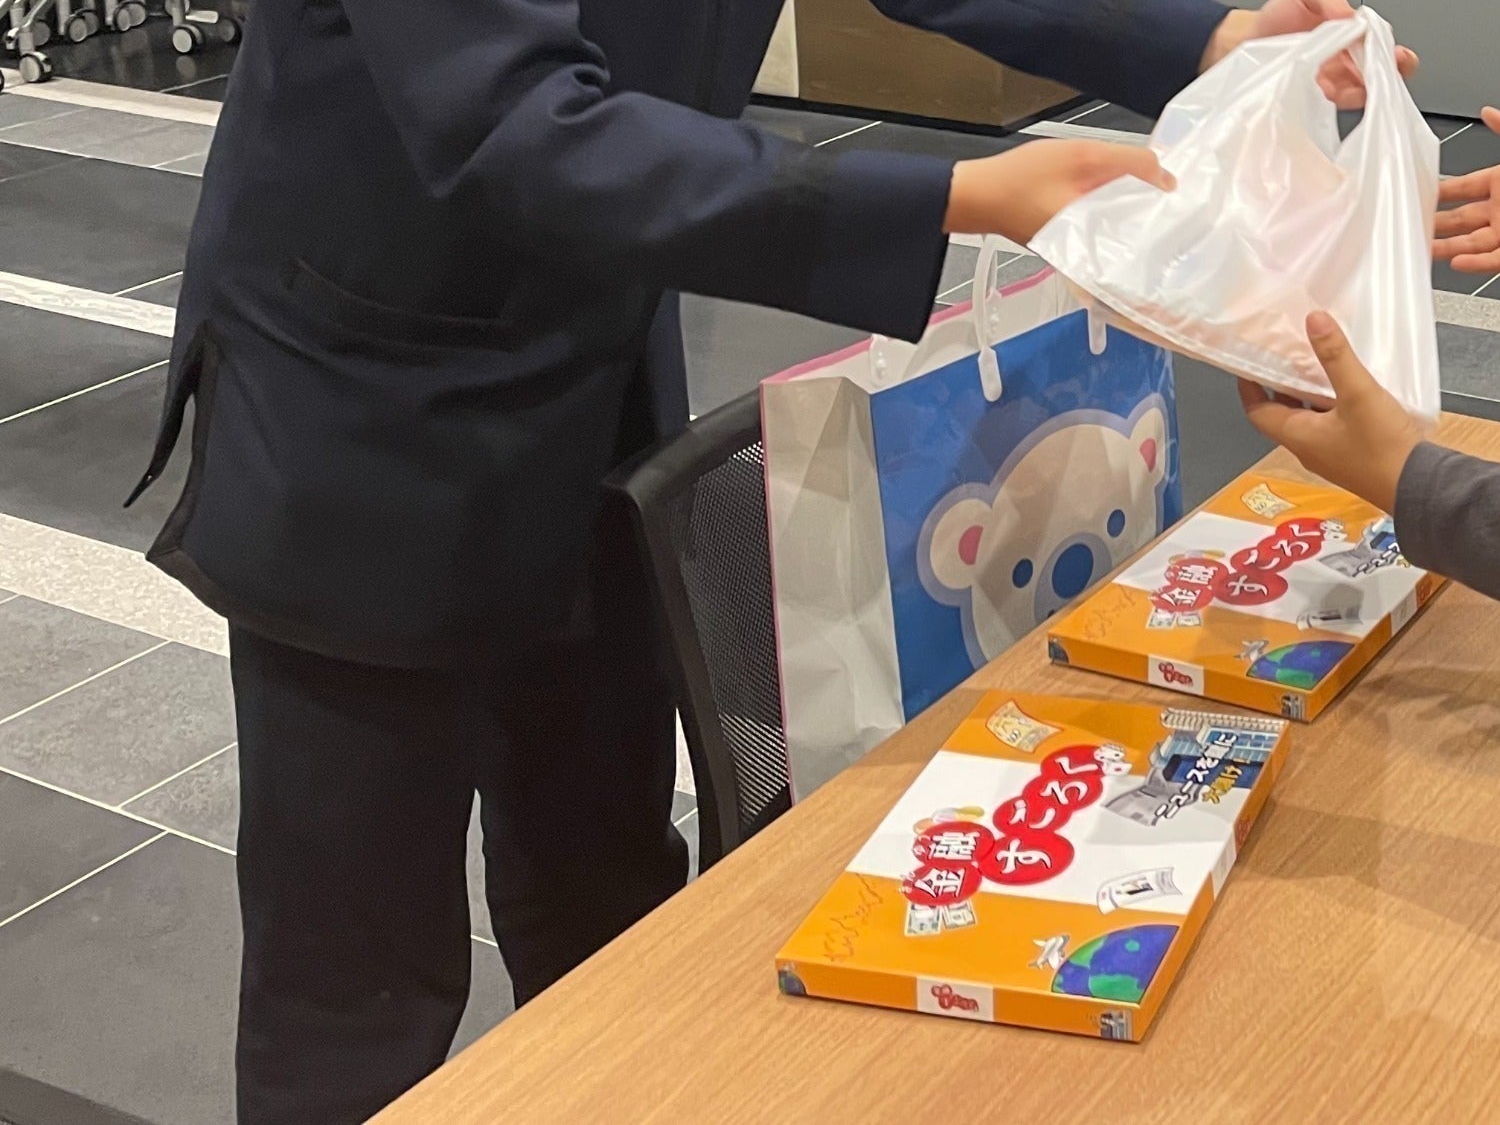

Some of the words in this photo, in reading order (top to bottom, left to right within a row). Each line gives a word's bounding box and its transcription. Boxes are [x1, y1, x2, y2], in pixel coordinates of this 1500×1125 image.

[1161, 565, 1219, 608] 金融
[1228, 524, 1321, 596] すごろく
[995, 756, 1099, 874] すごろく
[913, 831, 981, 899] 金融
